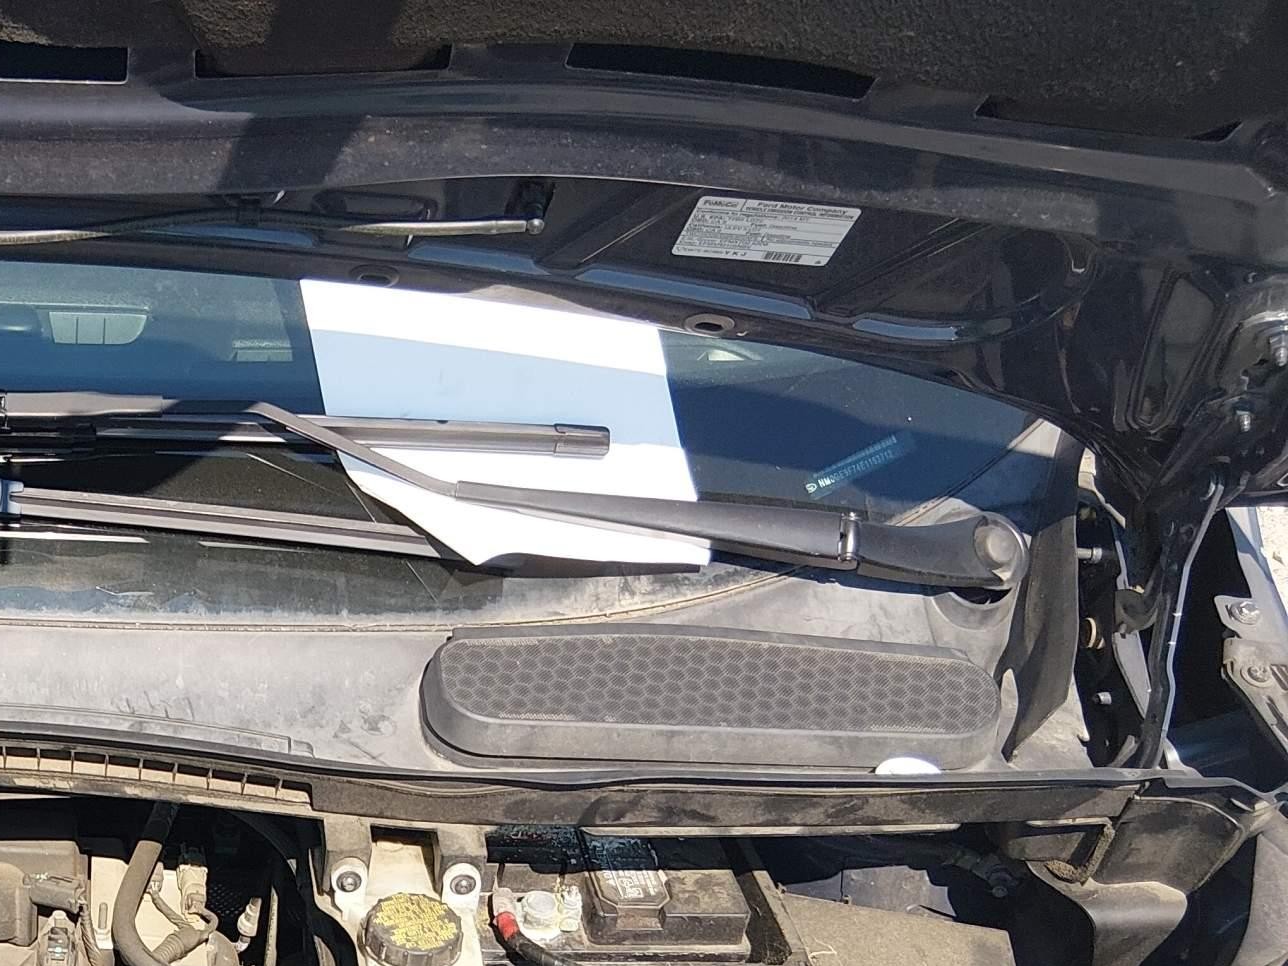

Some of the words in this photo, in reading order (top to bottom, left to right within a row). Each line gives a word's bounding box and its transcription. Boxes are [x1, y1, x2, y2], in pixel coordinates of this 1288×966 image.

[757, 201, 779, 209] Ford
[779, 203, 805, 211] Motor
[806, 205, 848, 216] Company
